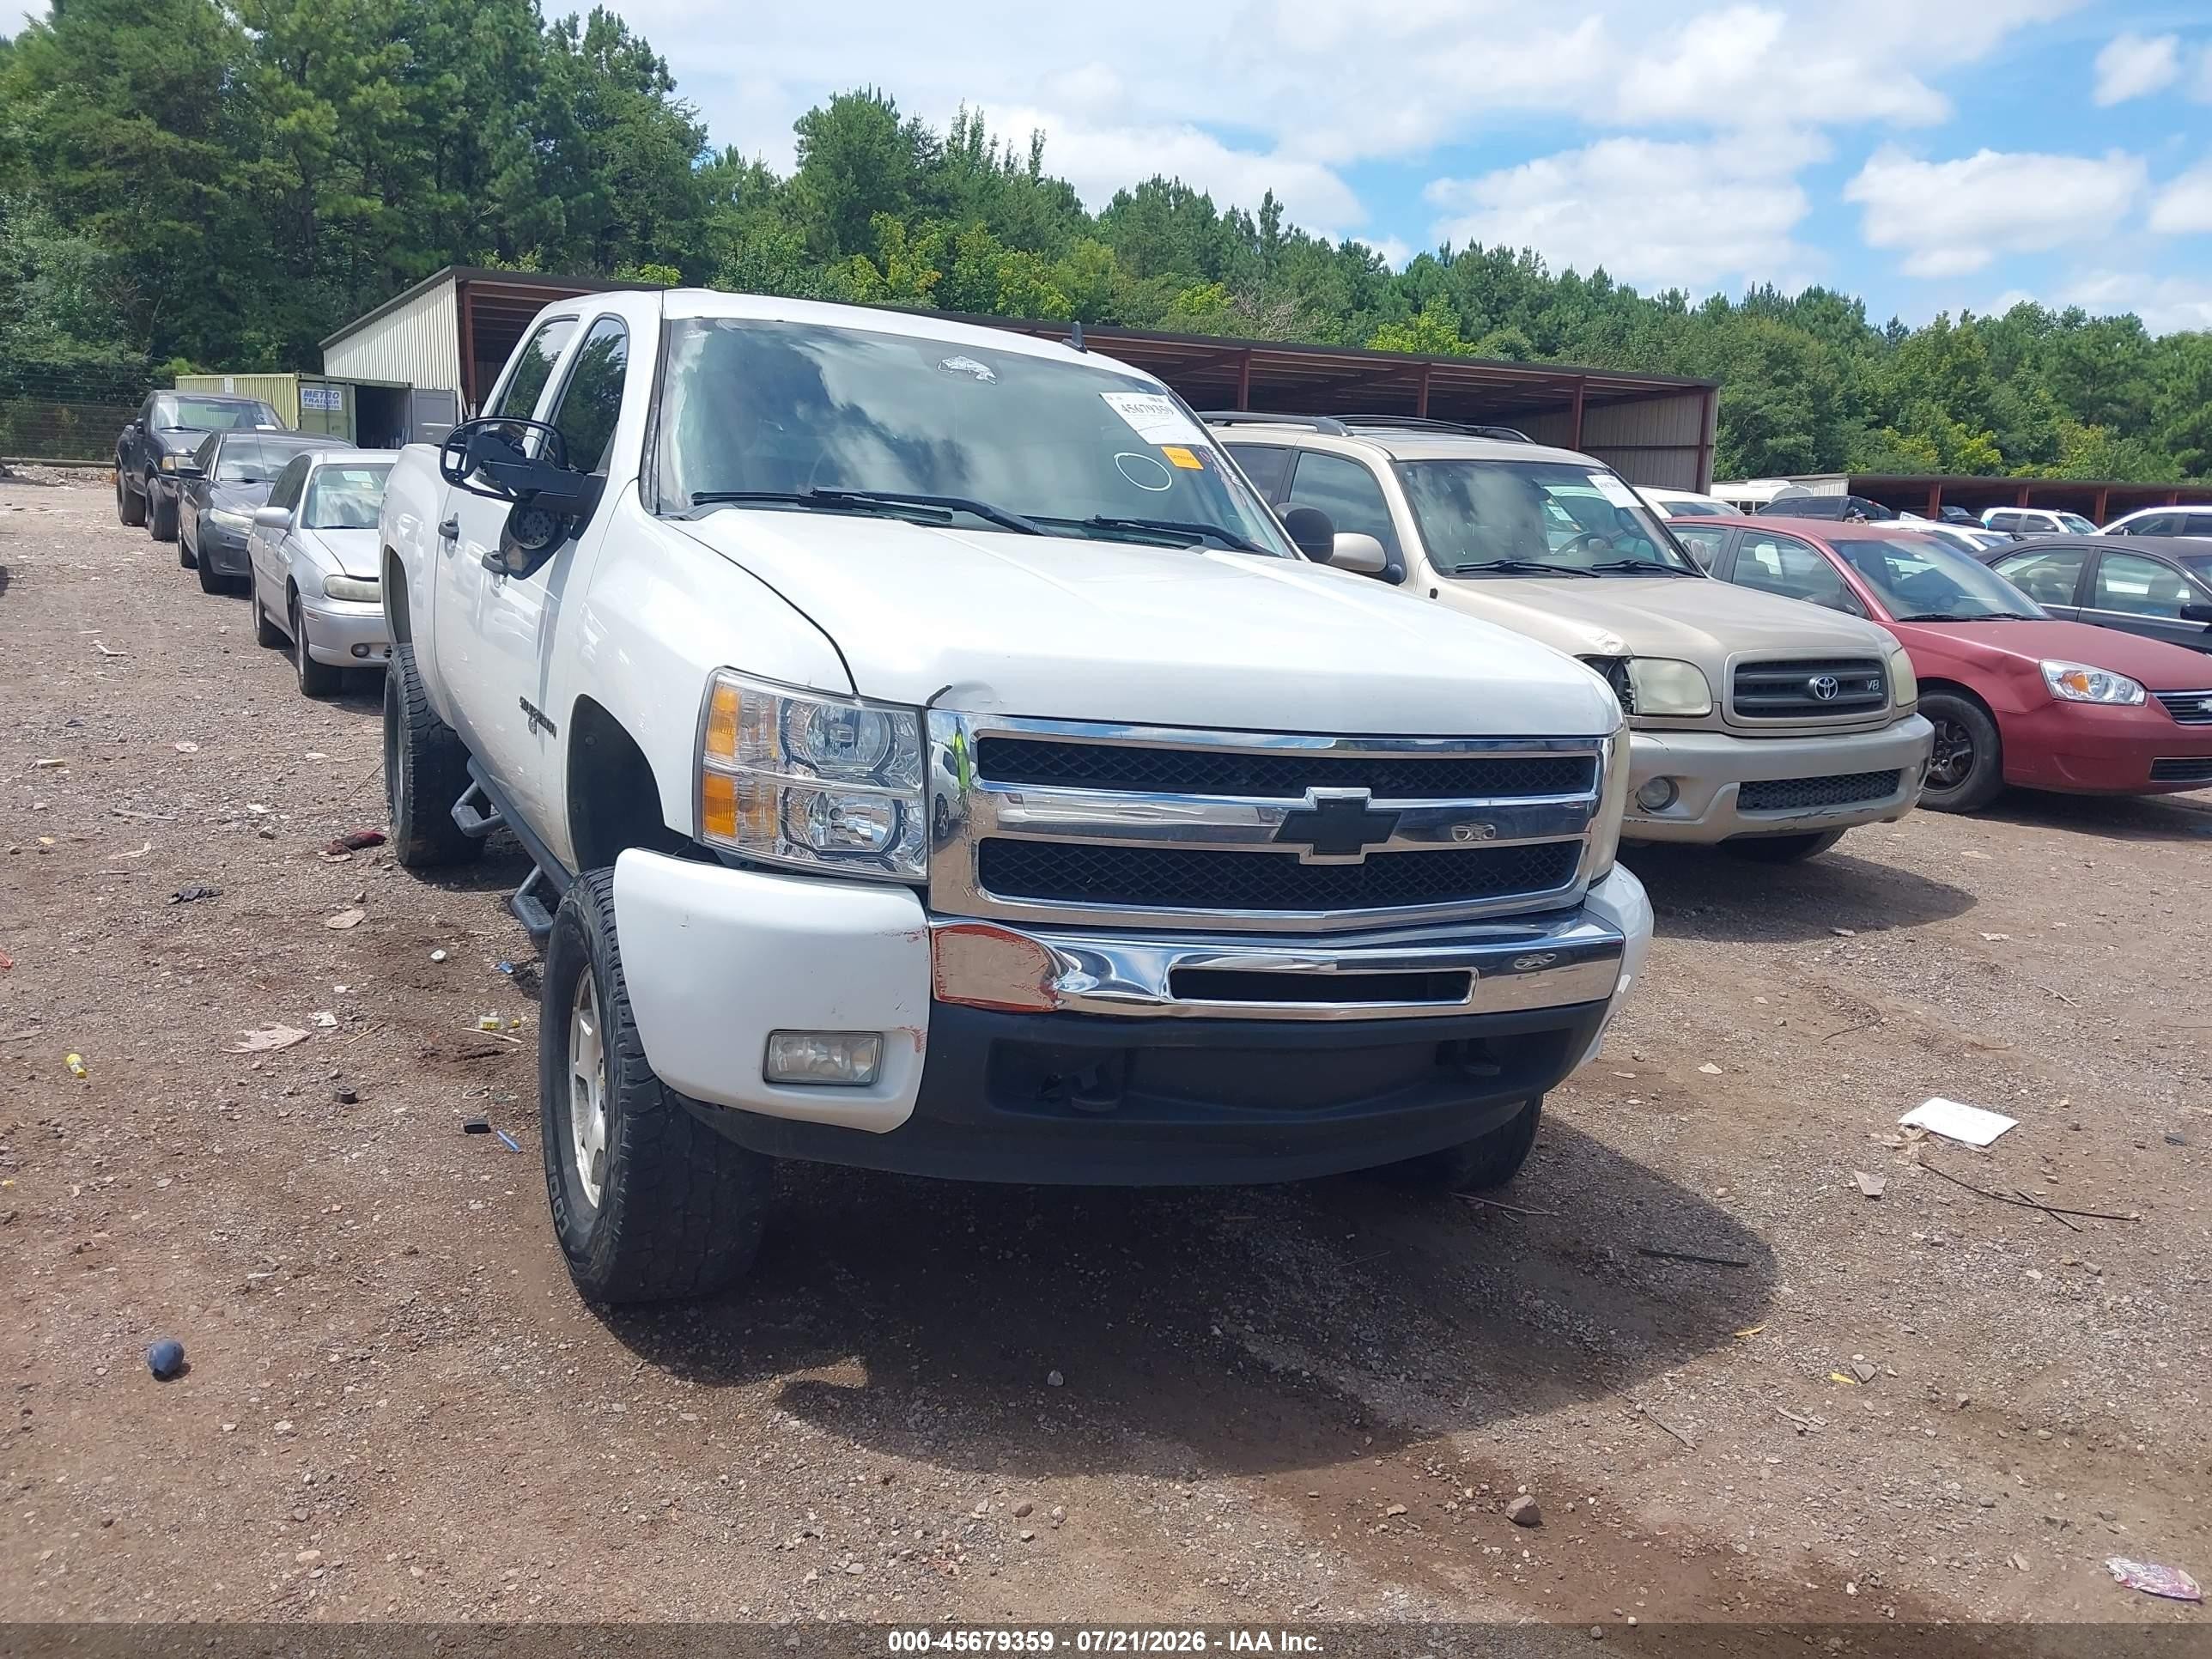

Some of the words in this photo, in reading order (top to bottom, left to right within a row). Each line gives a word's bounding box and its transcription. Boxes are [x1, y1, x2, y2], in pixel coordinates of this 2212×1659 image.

[303, 390, 340, 399] METRO
[1121, 404, 1174, 415] 45679359
[1865, 679, 1880, 690] V8
